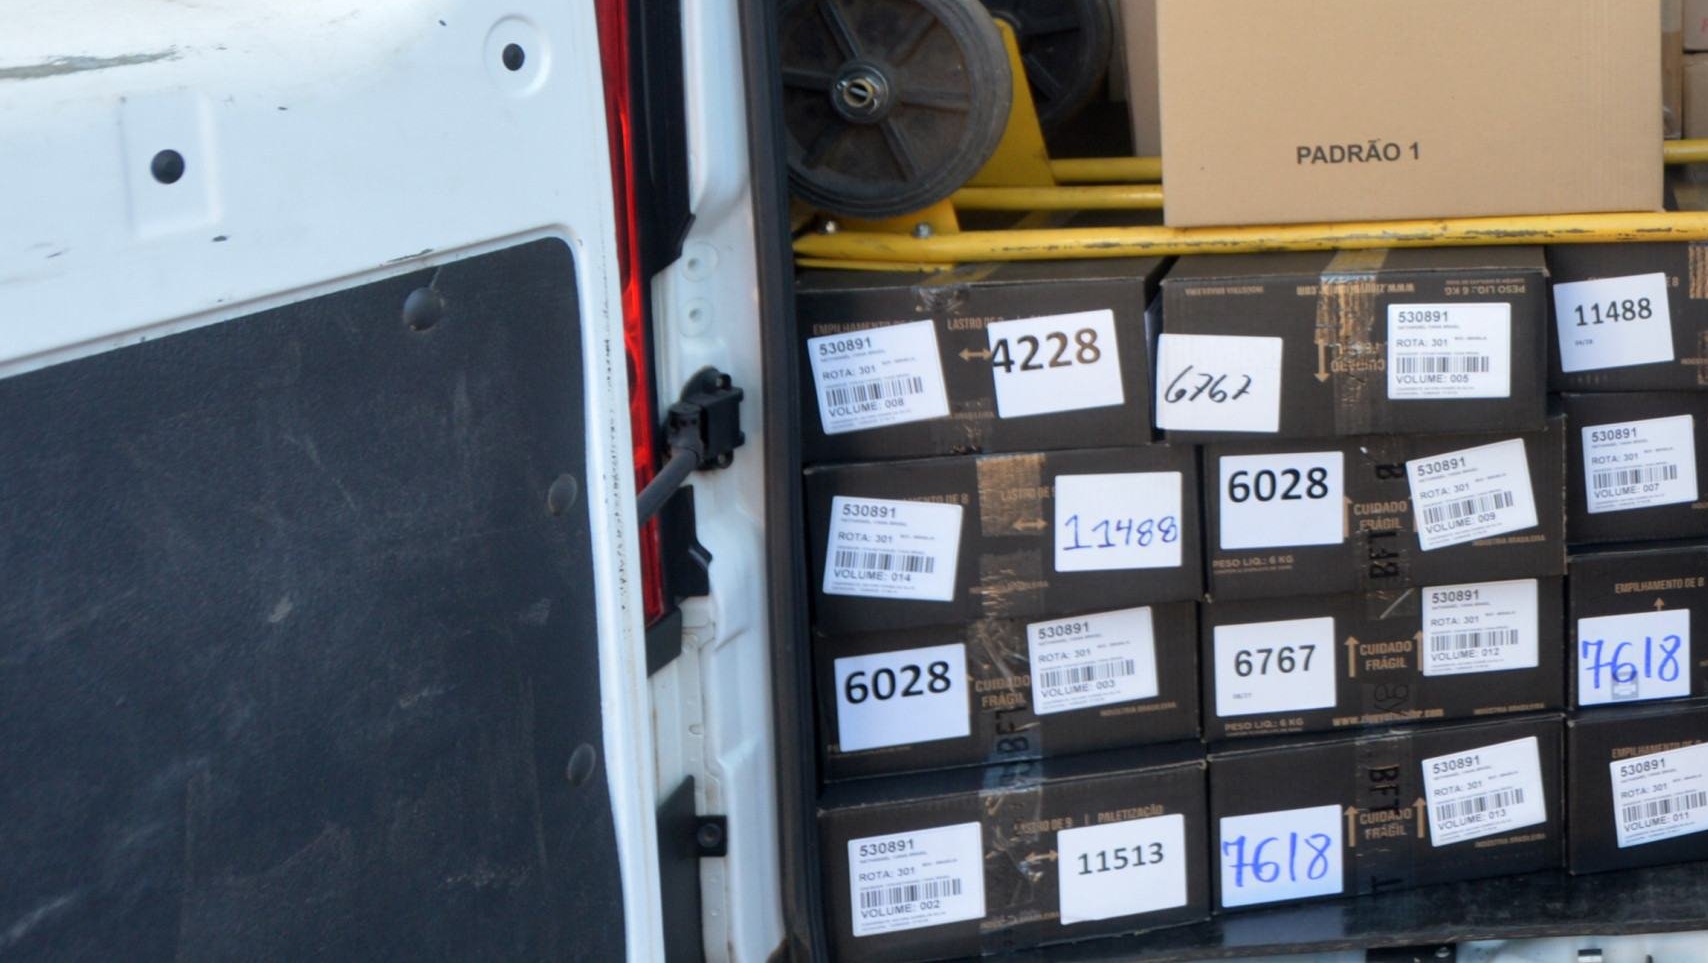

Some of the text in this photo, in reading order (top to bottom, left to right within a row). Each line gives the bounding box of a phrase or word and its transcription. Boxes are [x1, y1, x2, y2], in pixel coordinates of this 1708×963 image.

[1296, 139, 1421, 165] PADRÃO 1
[1398, 310, 1449, 324] 530891
[1574, 297, 1653, 327] 11488
[819, 337, 873, 356] 530891
[992, 328, 1102, 374] 4228
[1396, 338, 1428, 348] ROTA:
[822, 367, 856, 380] ROTA:
[1395, 374, 1448, 385] VOLUME:
[828, 402, 883, 418] VOLUME:
[1591, 427, 1638, 443] 530891
[1417, 456, 1467, 477] 530891
[1591, 454, 1621, 465] ROTA:
[1227, 467, 1329, 503] 6028
[1593, 485, 1641, 499] VOLUME:
[1419, 488, 1451, 500] ROTA:
[842, 503, 897, 518] 530891
[1353, 500, 1408, 516] CUIDADO
[1063, 514, 1178, 551] 11488
[1425, 517, 1475, 535] VOLUME:
[838, 531, 871, 543] ROTA:
[834, 568, 889, 582] VOLUME:
[1615, 578, 1683, 594] EMPILHAMENTO
[1432, 589, 1481, 604] 530891
[1430, 617, 1459, 627] ROTA:
[1038, 622, 1090, 640] 530891
[1359, 640, 1412, 657] CUIDADO
[1431, 649, 1480, 662] VOLUME:
[1038, 651, 1070, 663] ROTA:
[1234, 644, 1316, 678] 6767
[1365, 657, 1407, 671] FRÁGIL
[1582, 634, 1681, 689] 7618
[844, 661, 951, 705] 6028
[1041, 683, 1091, 698] VOLUME:
[1432, 755, 1481, 774] 530891
[1620, 758, 1665, 777] 530891
[1434, 786, 1464, 797] ROTA:
[1620, 787, 1649, 799] ROTA:
[1437, 814, 1486, 831] VOLUME:
[1624, 815, 1671, 832] VOLUME:
[859, 839, 915, 857] 530891
[1077, 842, 1165, 876] 11513
[1222, 832, 1332, 887] 7618
[858, 870, 893, 882] ROTA:
[860, 903, 917, 919] VOLUME:
